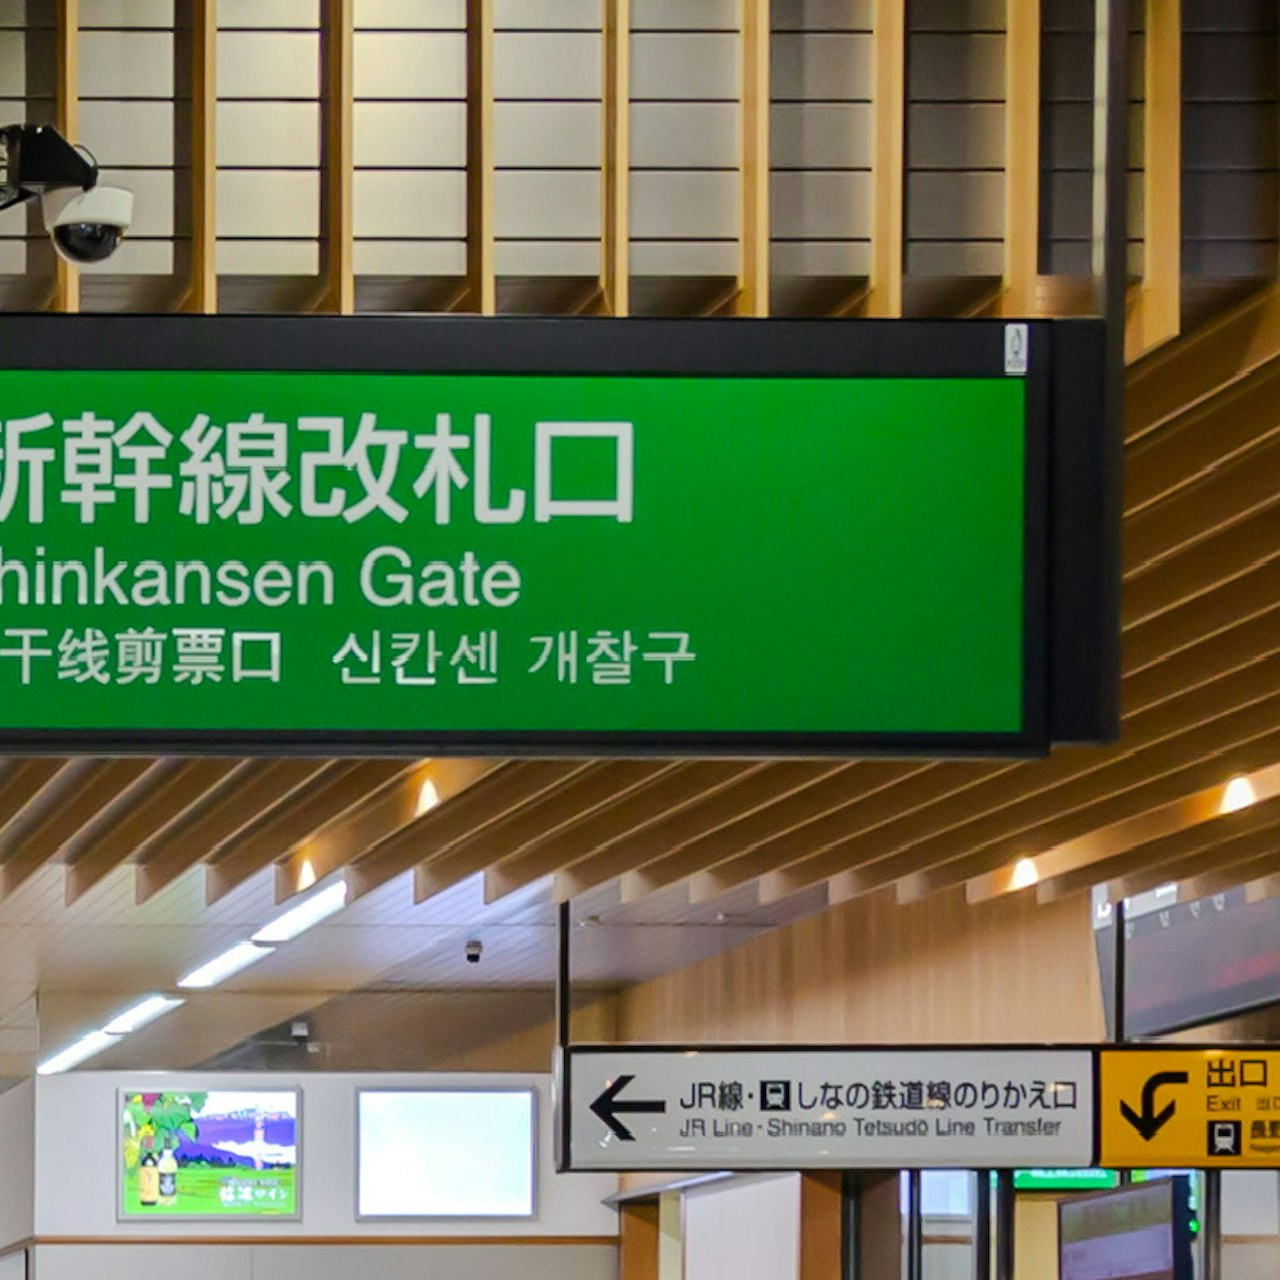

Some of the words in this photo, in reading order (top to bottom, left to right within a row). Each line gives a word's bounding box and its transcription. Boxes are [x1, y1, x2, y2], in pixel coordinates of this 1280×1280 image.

[360, 545, 521, 607] Gate
[331, 629, 498, 685] 신칸센
[528, 631, 696, 685] 개찰구
[1207, 1058, 1268, 1088] 出口
[798, 1081, 1078, 1111] しなの鉄道線のりかえ口
[1206, 1095, 1241, 1113] Exit
[679, 1118, 706, 1138] JR
[767, 1118, 847, 1138] Shinano
[935, 1118, 976, 1138] Line
[984, 1118, 1063, 1138] Transfer
